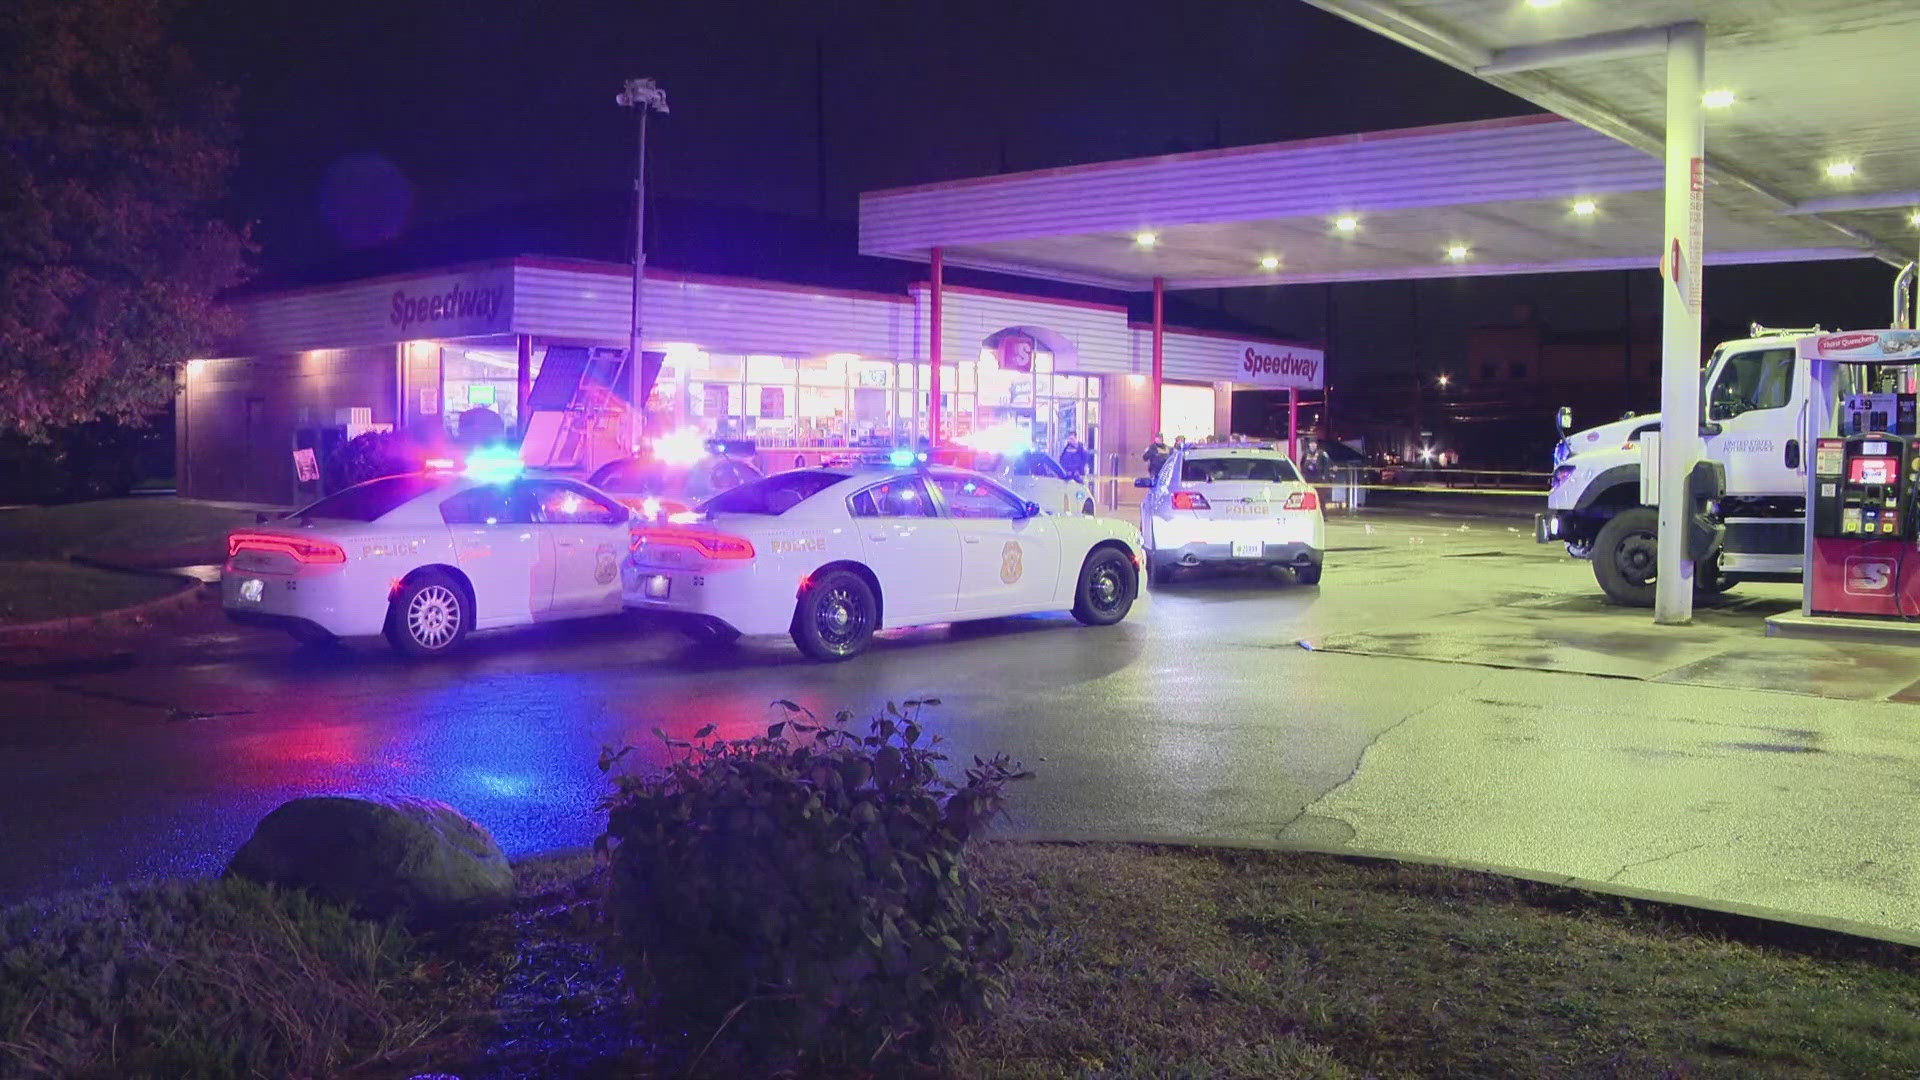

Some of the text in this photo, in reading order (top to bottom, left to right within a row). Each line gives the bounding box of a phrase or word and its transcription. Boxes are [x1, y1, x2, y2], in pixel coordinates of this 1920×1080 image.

[390, 283, 504, 331] Speedway
[1841, 336, 1876, 347] Quenchers
[1243, 347, 1319, 381] Speedway
[1723, 438, 1774, 447] UNITED STATES
[1748, 445, 1775, 453] SERVICE
[1225, 505, 1270, 515] POLICE
[362, 541, 418, 558] POLICE
[771, 538, 826, 553] POLICE
